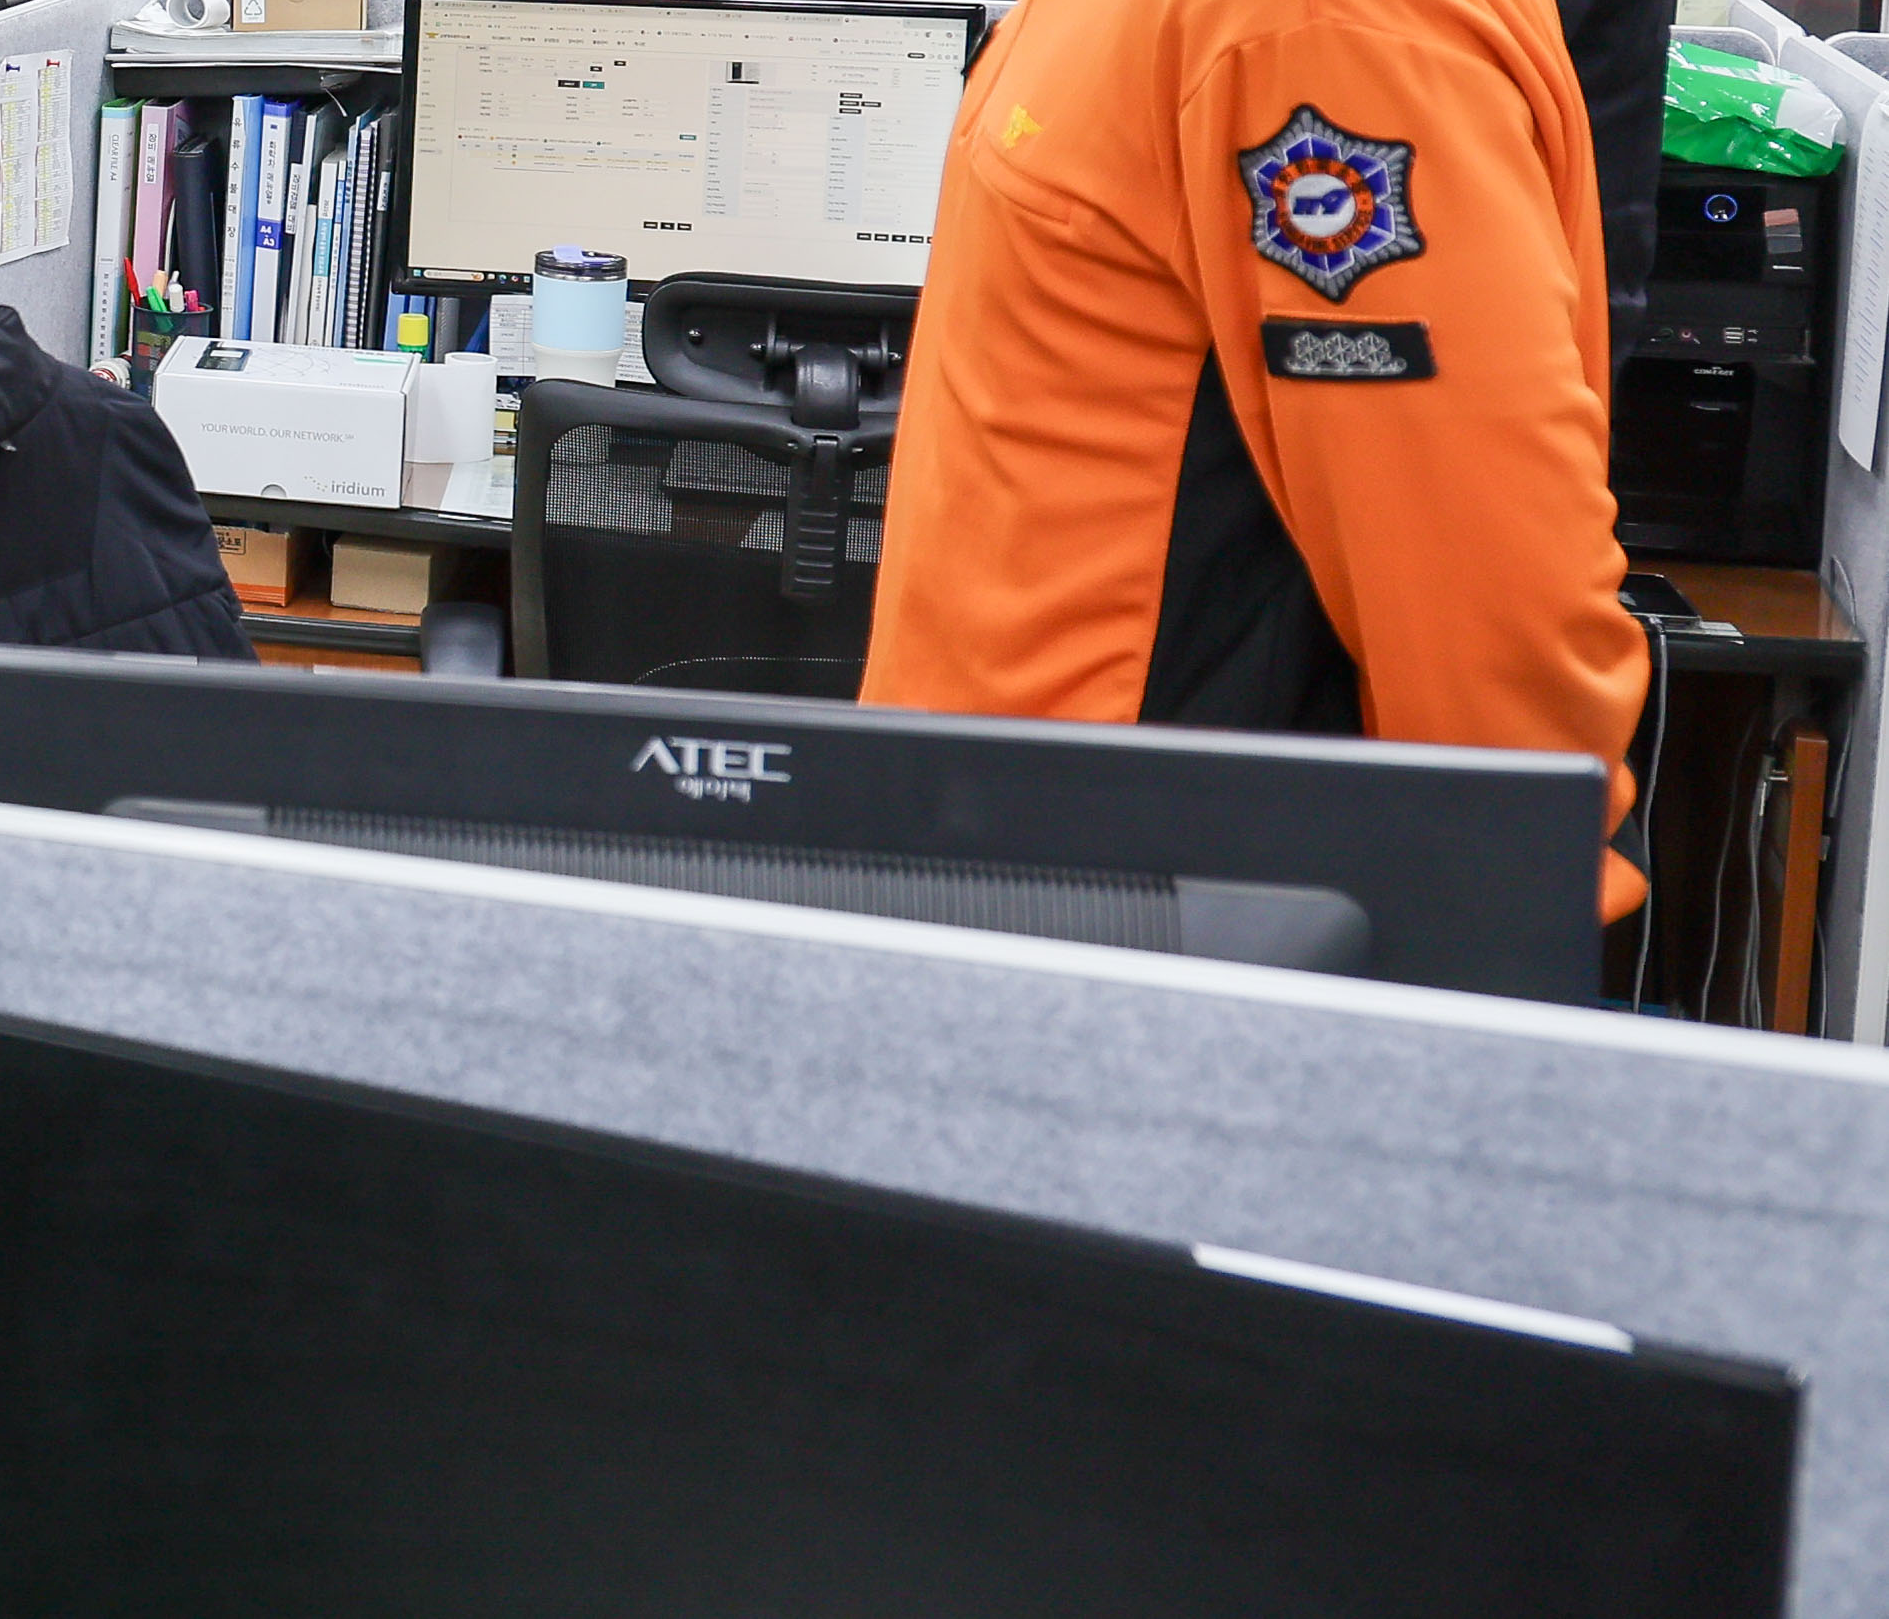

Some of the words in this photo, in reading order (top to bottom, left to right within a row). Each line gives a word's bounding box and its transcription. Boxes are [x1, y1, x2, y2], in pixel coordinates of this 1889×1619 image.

[111, 134, 120, 156] CLEAR
[109, 171, 118, 181] A4
[260, 225, 272, 233] A4
[263, 236, 275, 246] A3
[201, 422, 228, 435] YOUR
[229, 425, 268, 438] WORLD.
[269, 428, 292, 440] OUR
[331, 480, 386, 499] iridium
[630, 735, 794, 784] ATEC
